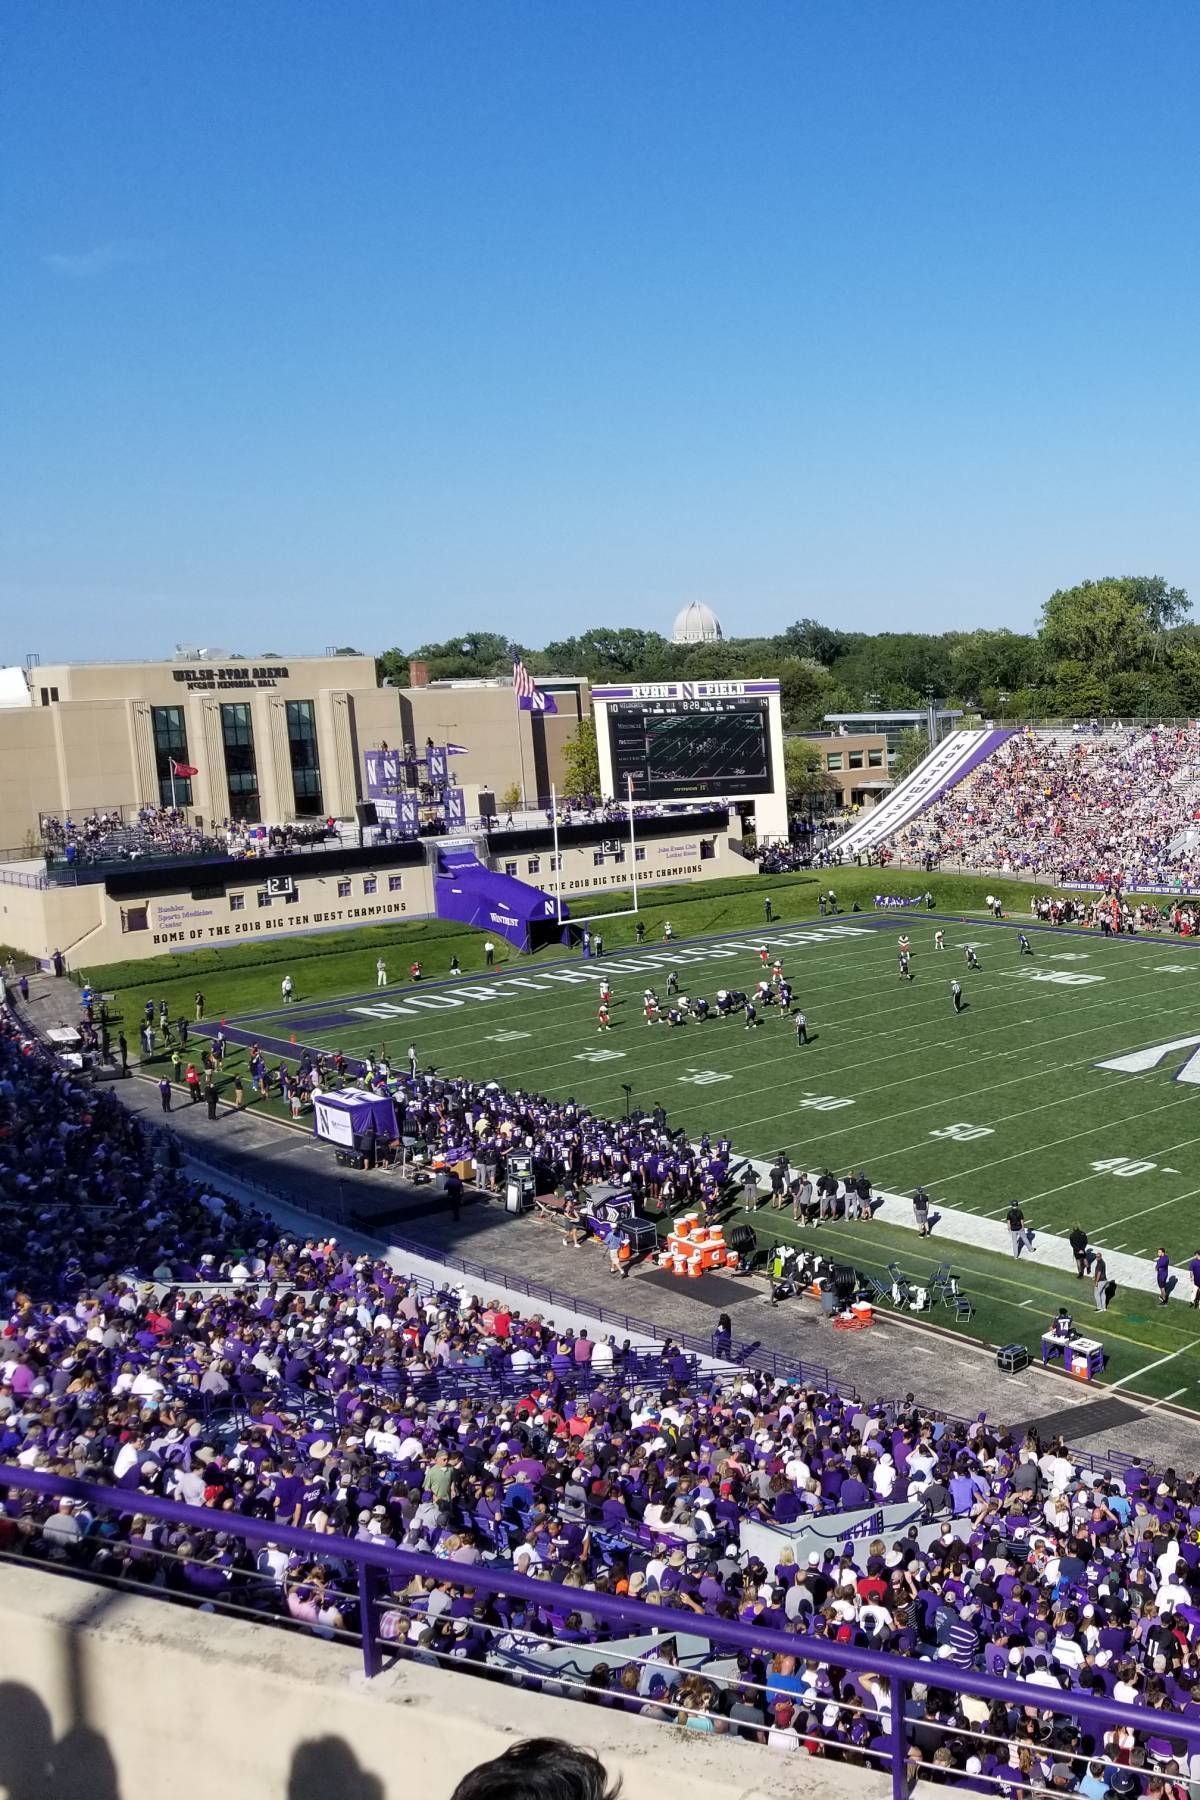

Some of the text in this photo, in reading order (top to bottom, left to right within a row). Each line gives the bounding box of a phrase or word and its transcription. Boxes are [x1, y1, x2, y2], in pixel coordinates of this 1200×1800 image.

[172, 667, 290, 682] WELSH-RYAN ARENA
[217, 680, 256, 689] MEMORIAL
[258, 680, 277, 688] HALL
[632, 686, 669, 698] RYAN
[707, 683, 745, 695] FIELD
[368, 760, 376, 784] N
[384, 760, 396, 778] N
[432, 756, 444, 774] N
[402, 803, 414, 822] N
[449, 800, 461, 818] N
[569, 878, 590, 888] 2018
[593, 876, 606, 886] BIG
[610, 873, 627, 883] TEN
[656, 864, 702, 878] CHAMPIONS
[544, 901, 554, 915] N
[153, 902, 406, 944] HOME OF THE 2018 BIG TEN WEST CHAMPIONS
[350, 924, 878, 1020] NORTHWESTERN
[677, 1070, 734, 1084] 30
[799, 1095, 856, 1111] 40
[318, 1104, 330, 1136] N
[928, 1122, 995, 1141] 50
[679, 1165, 688, 1174] 10
[1089, 1157, 1158, 1177] 40
[1059, 1322, 1069, 1331] 14
